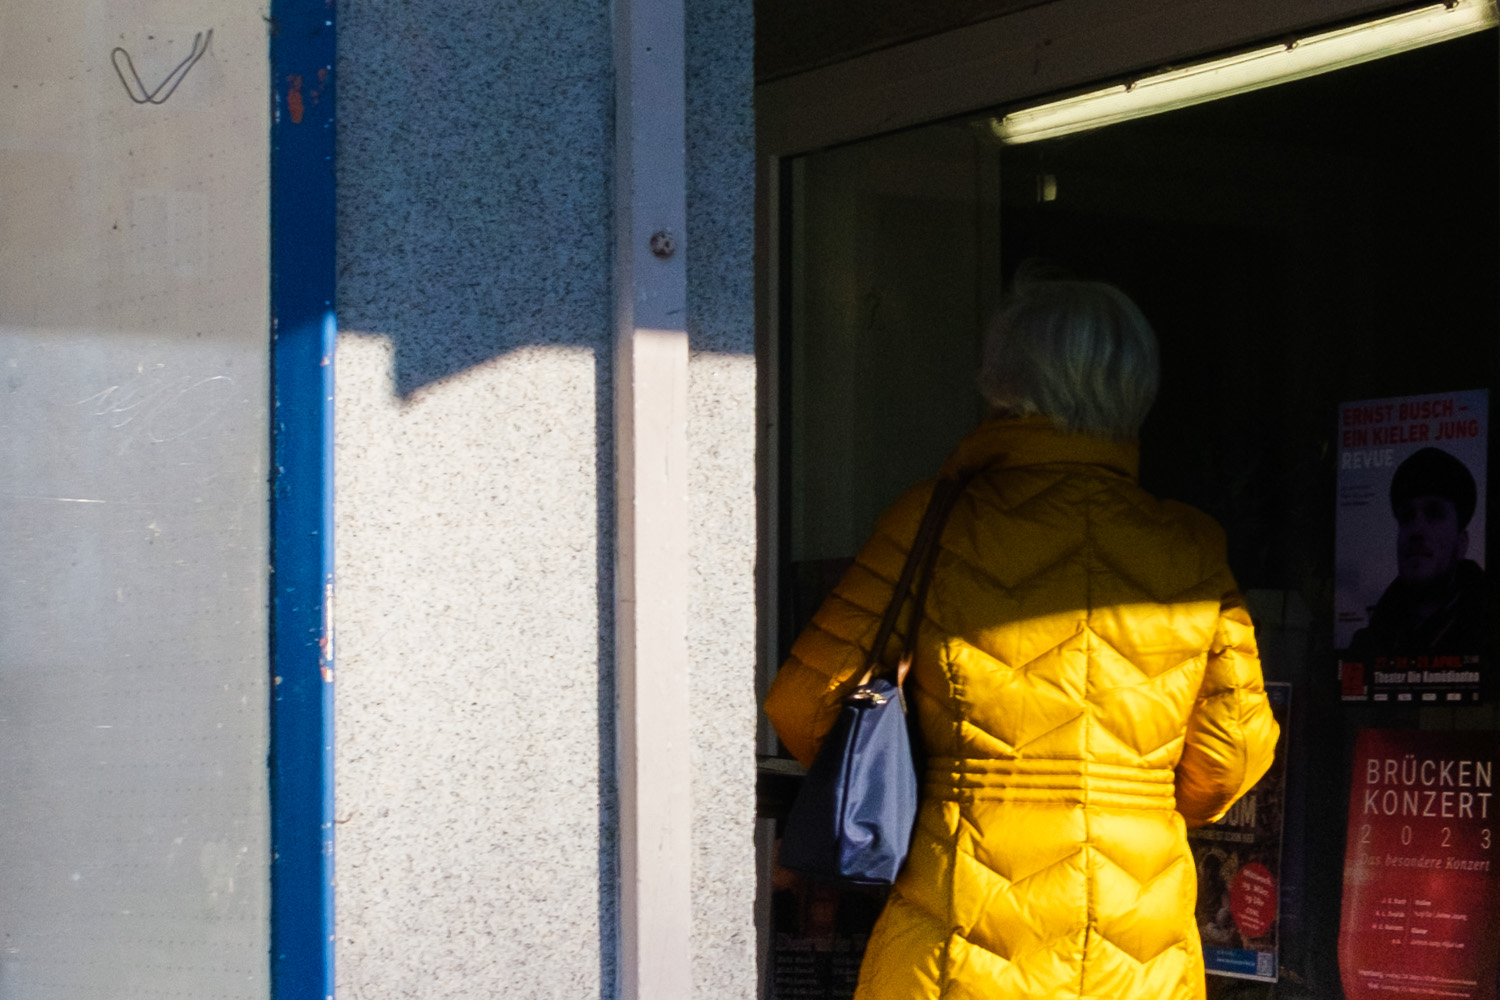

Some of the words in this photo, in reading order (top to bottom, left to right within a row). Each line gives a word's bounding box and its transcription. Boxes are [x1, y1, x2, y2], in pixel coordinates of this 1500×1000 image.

[1343, 405, 1393, 426] ERNST
[1399, 400, 1454, 420] BUSCH
[1343, 429, 1368, 448] EIN
[1373, 424, 1429, 445] KIELER
[1435, 419, 1479, 441] JUNG
[1341, 449, 1393, 470] REVUE
[1366, 754, 1492, 788] BRÜCKEN
[1363, 789, 1493, 819] KONZERT
[1385, 854, 1442, 869] besondere
[1445, 857, 1491, 872] Konzert
